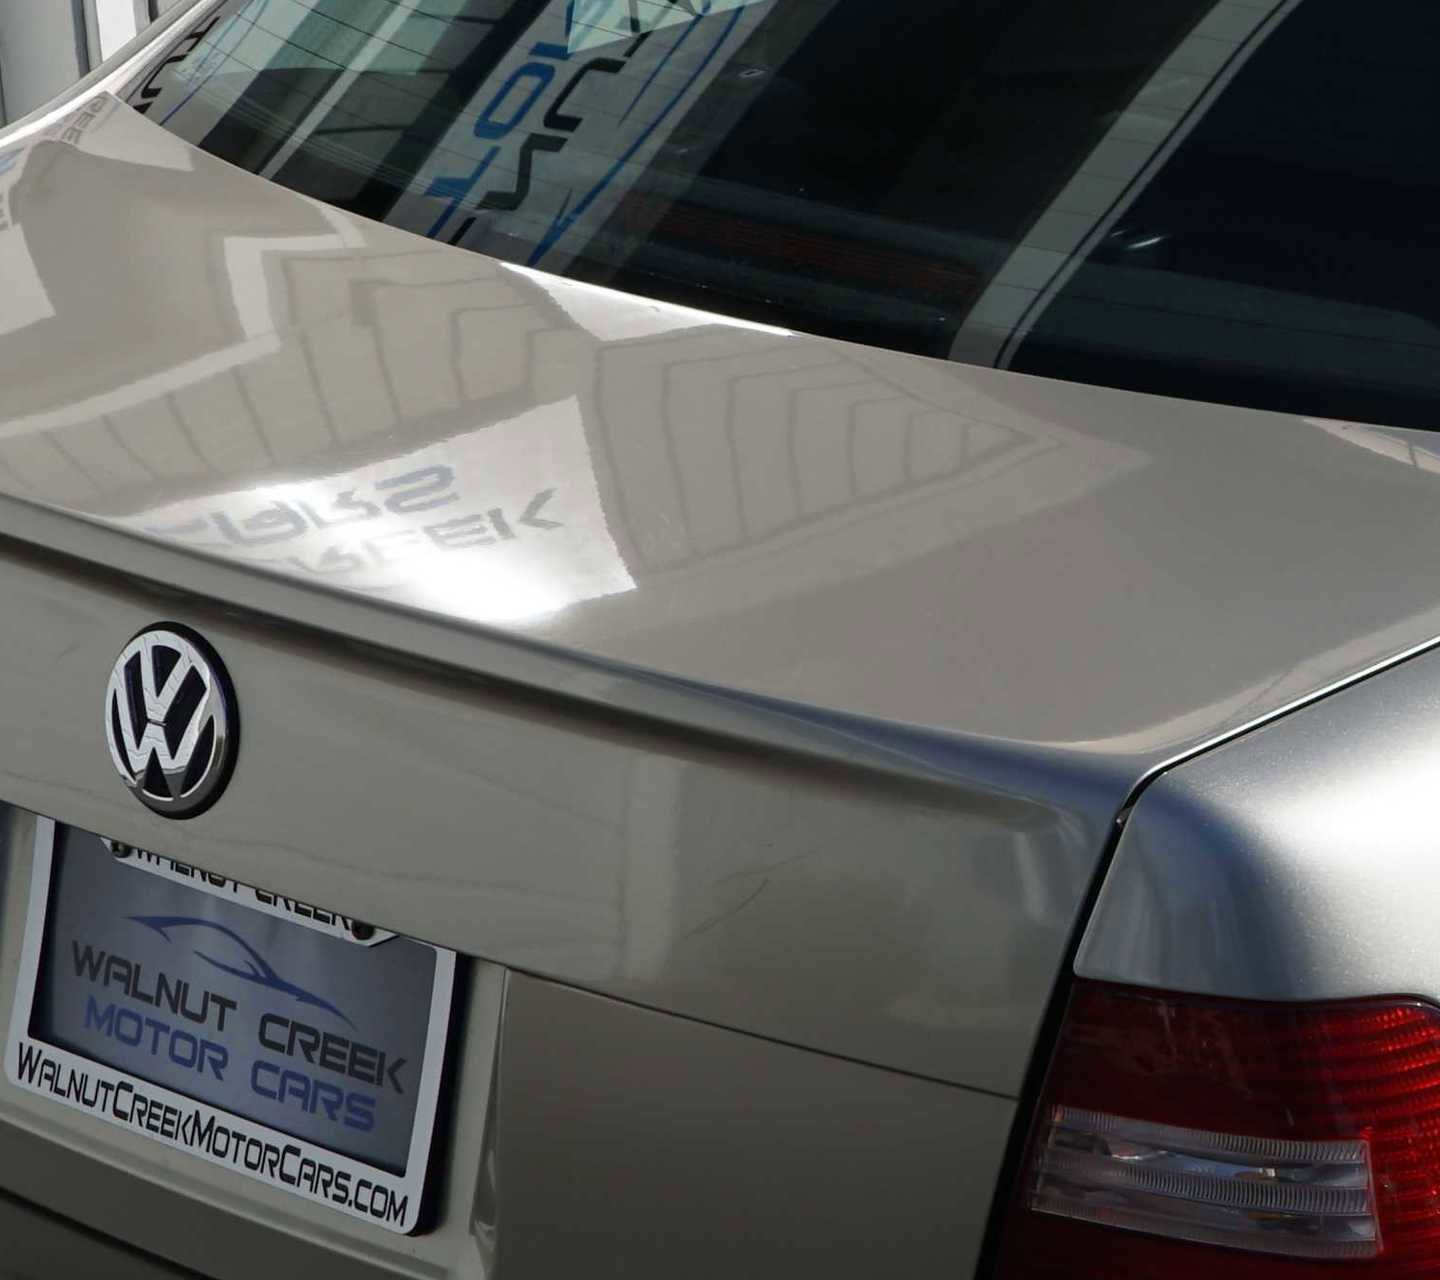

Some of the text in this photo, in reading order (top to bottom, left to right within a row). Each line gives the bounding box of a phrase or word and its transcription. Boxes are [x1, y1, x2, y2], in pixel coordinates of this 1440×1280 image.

[71, 939, 408, 1095] WALNUT CREEK
[83, 995, 377, 1134] MOTOR CARS
